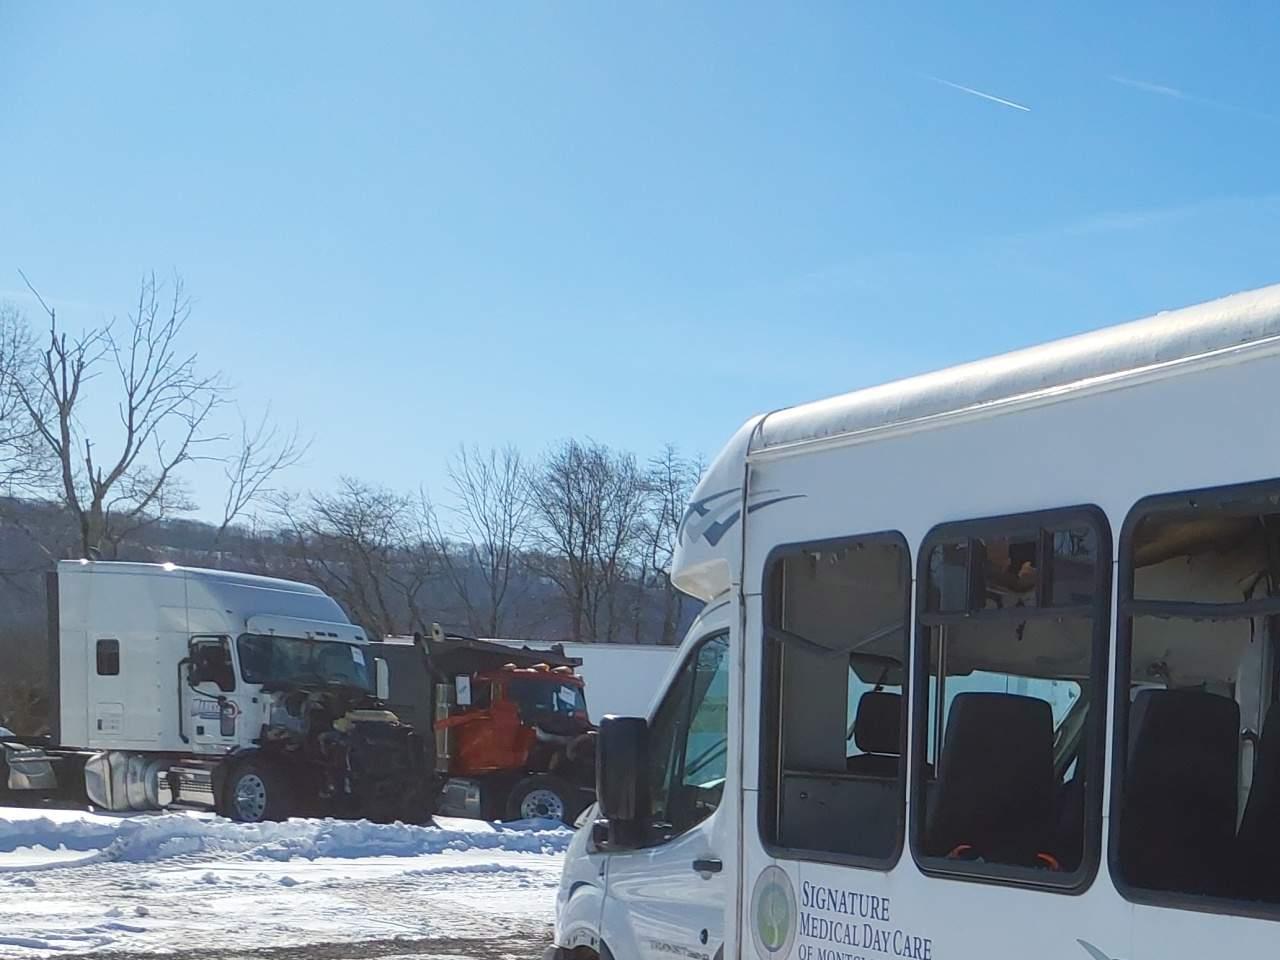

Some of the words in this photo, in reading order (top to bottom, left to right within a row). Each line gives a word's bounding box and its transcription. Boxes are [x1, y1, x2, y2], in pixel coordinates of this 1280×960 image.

[802, 880, 890, 921] SIGNATURE
[799, 911, 859, 947] MEDICAL
[863, 923, 891, 955] DAY
[799, 943, 813, 960] OF
